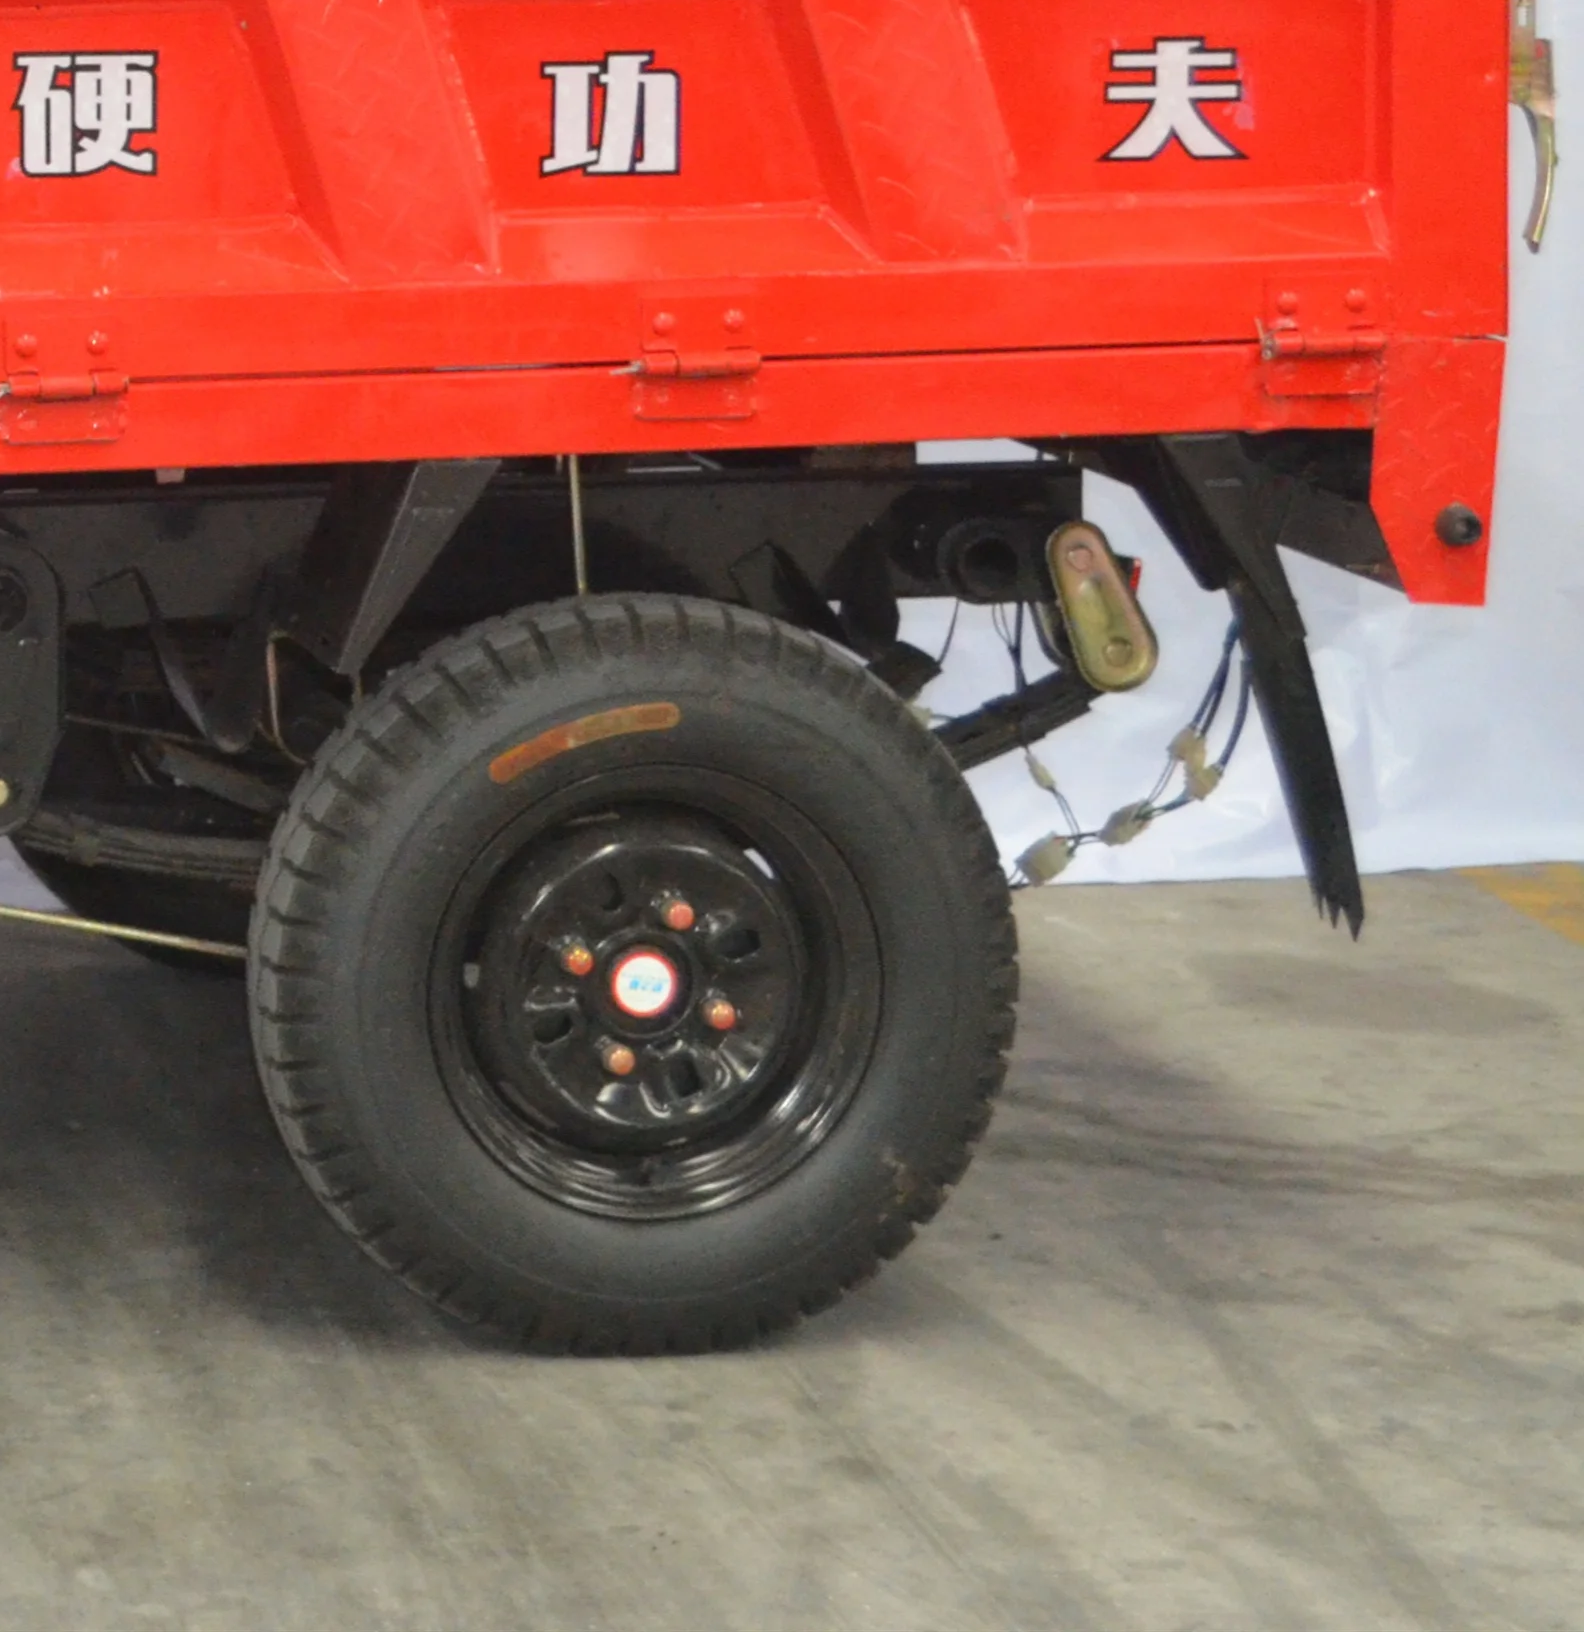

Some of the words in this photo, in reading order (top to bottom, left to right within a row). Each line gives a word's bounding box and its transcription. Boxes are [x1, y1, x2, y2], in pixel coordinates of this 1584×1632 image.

[11, 50, 158, 176] 硬
[539, 50, 681, 176] 功
[1097, 36, 1249, 162] 夫
